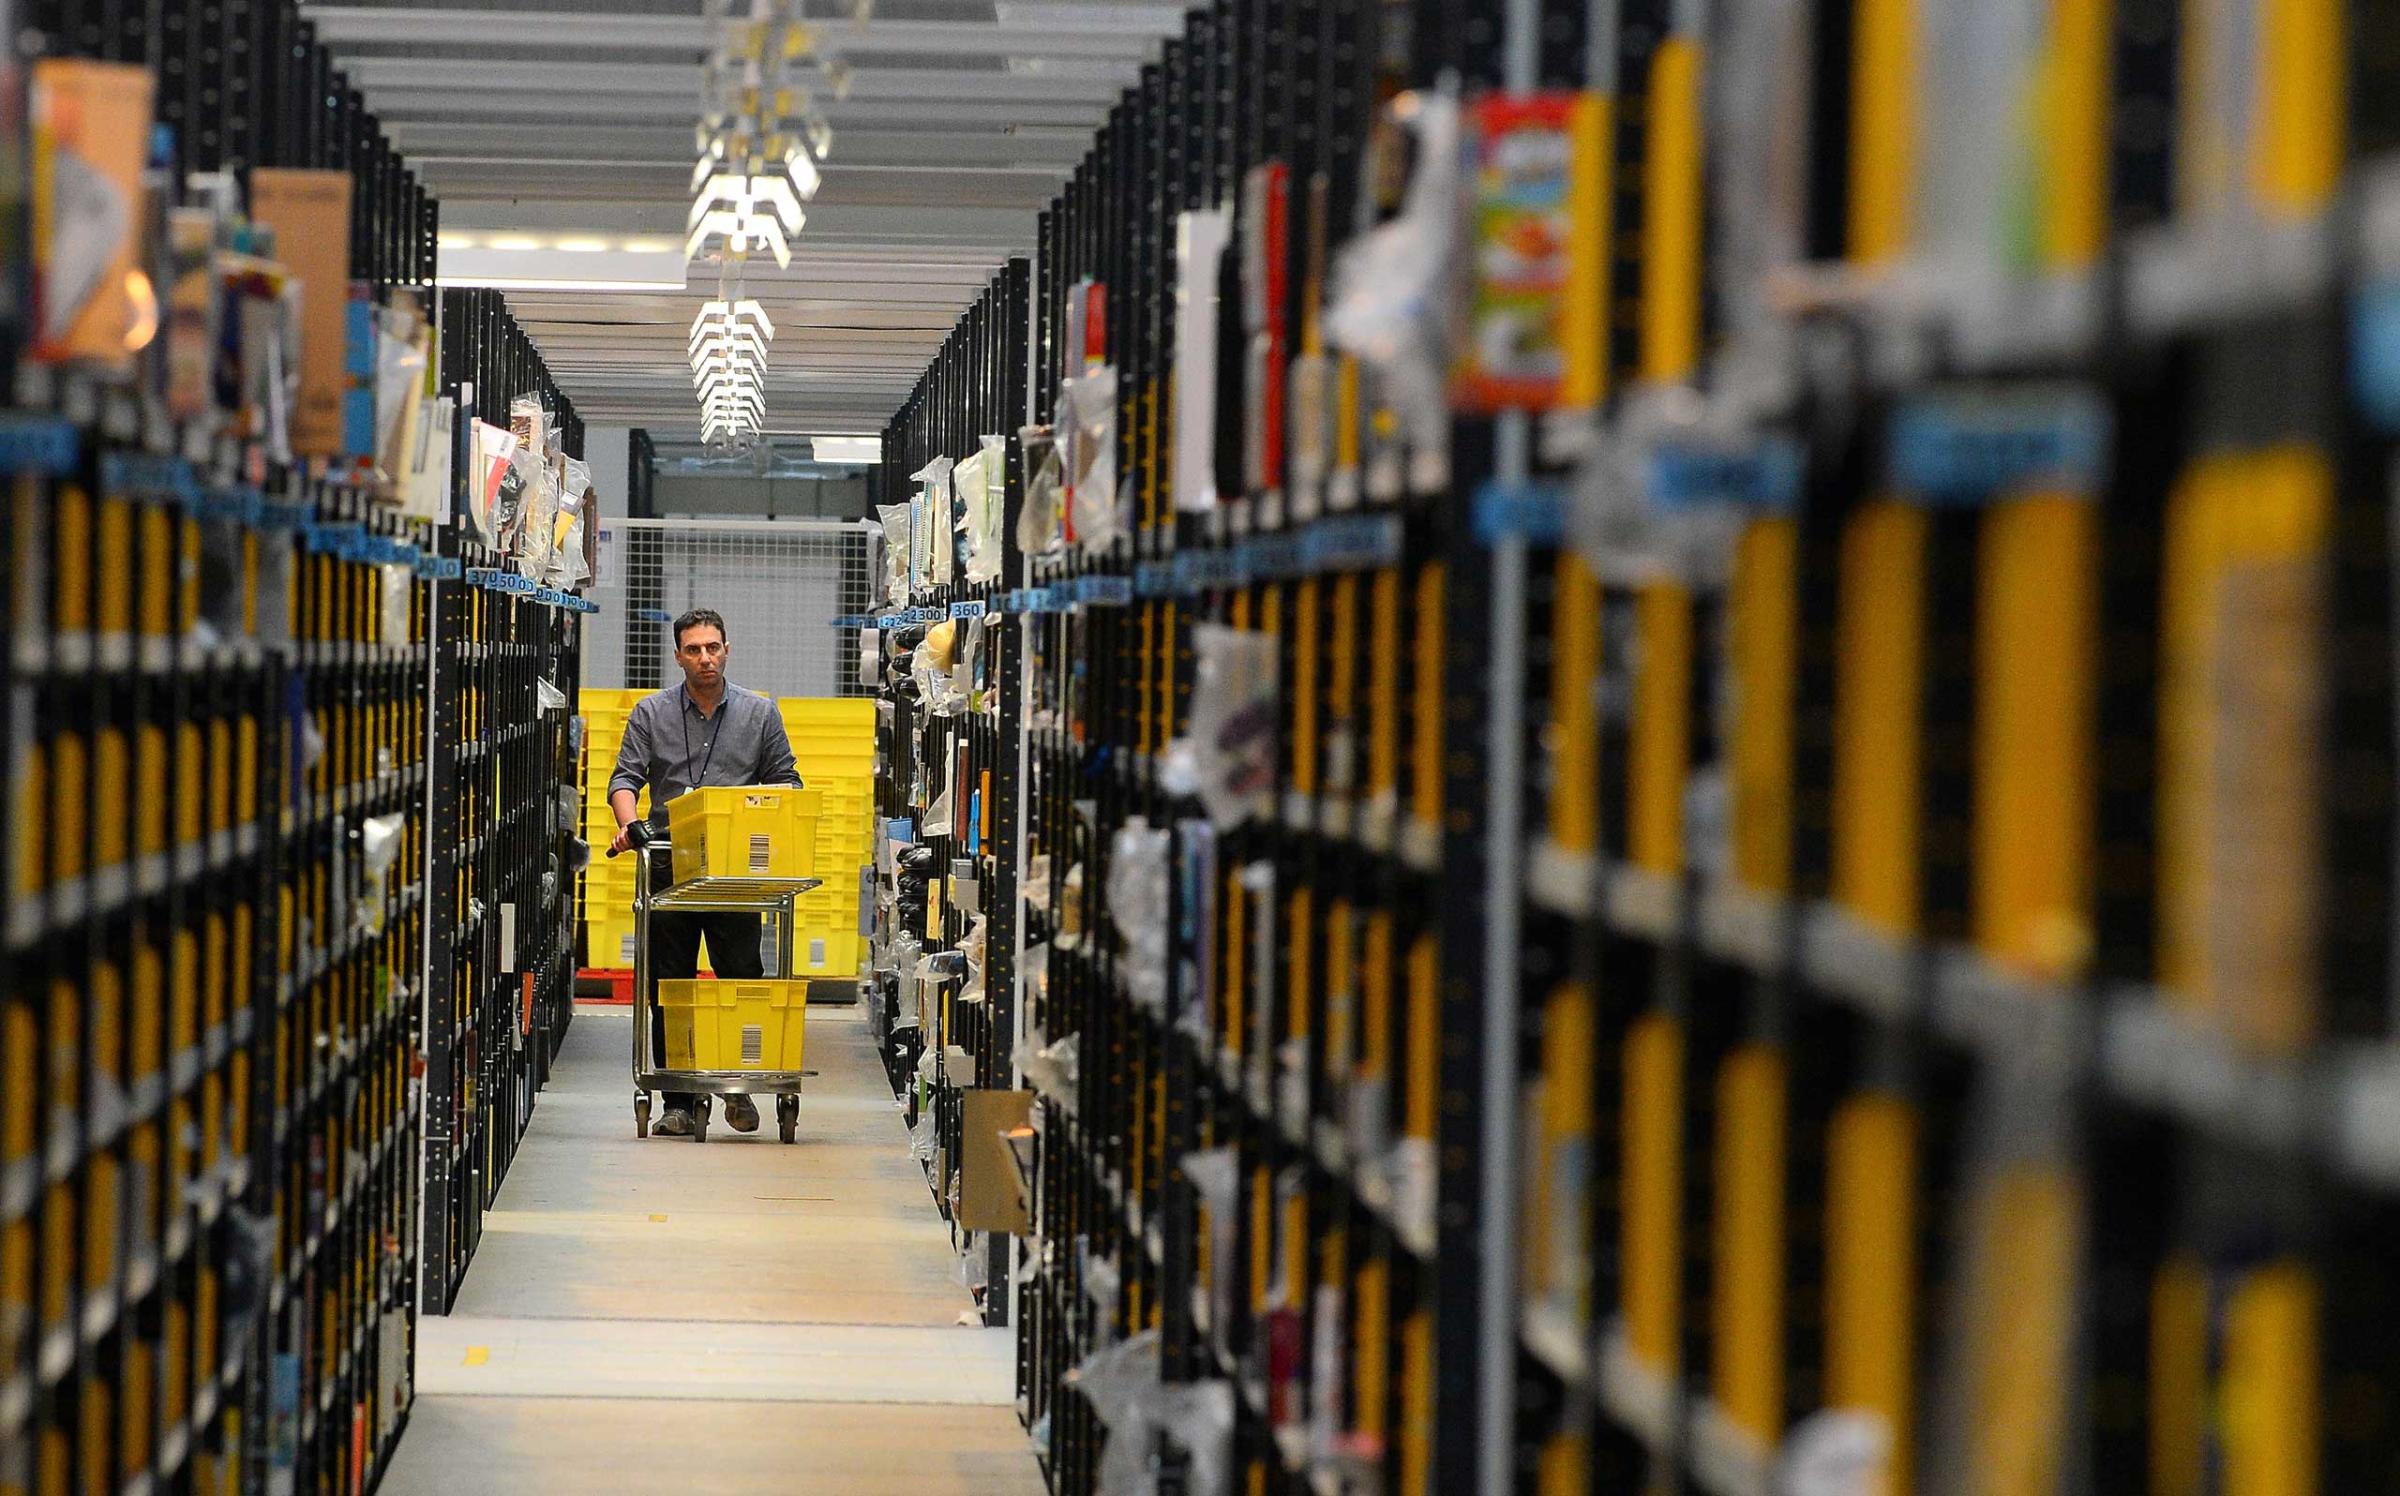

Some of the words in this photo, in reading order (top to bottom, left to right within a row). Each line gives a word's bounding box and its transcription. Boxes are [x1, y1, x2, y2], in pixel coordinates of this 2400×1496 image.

[470, 570, 498, 583] 370
[918, 610, 941, 620] 300
[954, 604, 980, 616] 360
